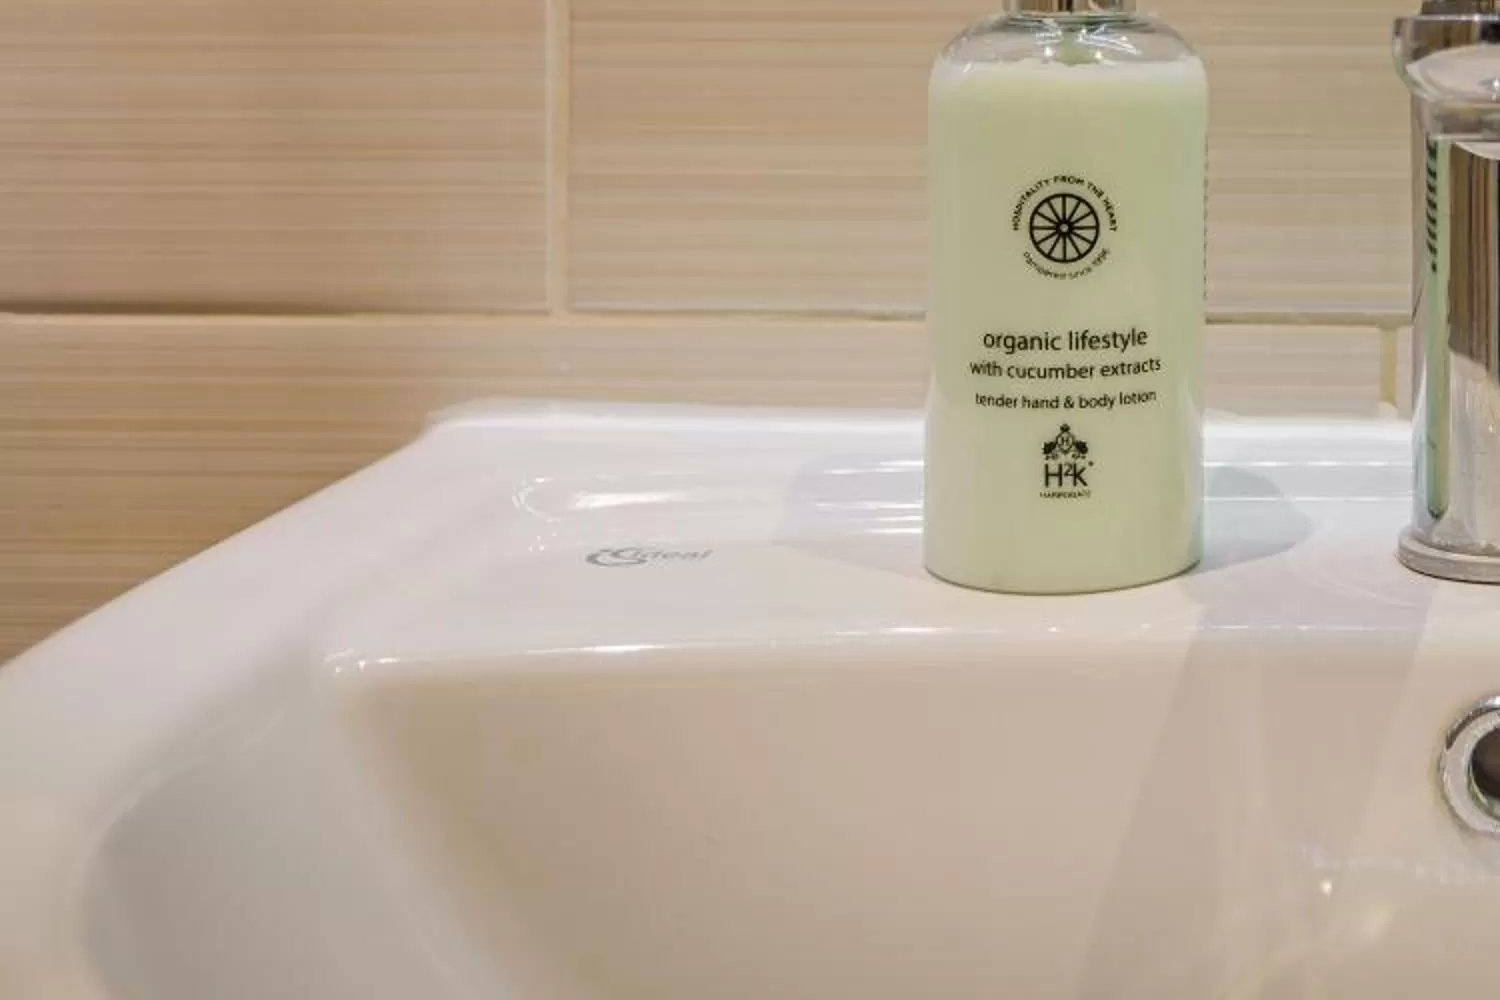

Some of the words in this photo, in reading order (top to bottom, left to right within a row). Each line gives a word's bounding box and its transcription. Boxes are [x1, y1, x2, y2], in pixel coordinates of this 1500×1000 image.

[1012, 178, 1051, 232] HOSPITALITY
[1053, 175, 1085, 185] FROM
[1087, 181, 1105, 199] THE
[1103, 196, 1117, 233] HEART
[983, 331, 1062, 355] organic
[1068, 327, 1148, 353] lifestyle
[969, 360, 1003, 377] with
[1007, 363, 1095, 380] cucumber
[1101, 357, 1161, 378] extracts
[975, 392, 1018, 409] tender
[1022, 395, 1060, 409] hand
[1063, 396, 1074, 409] &
[1078, 394, 1115, 411] body
[1119, 391, 1157, 406] lotion
